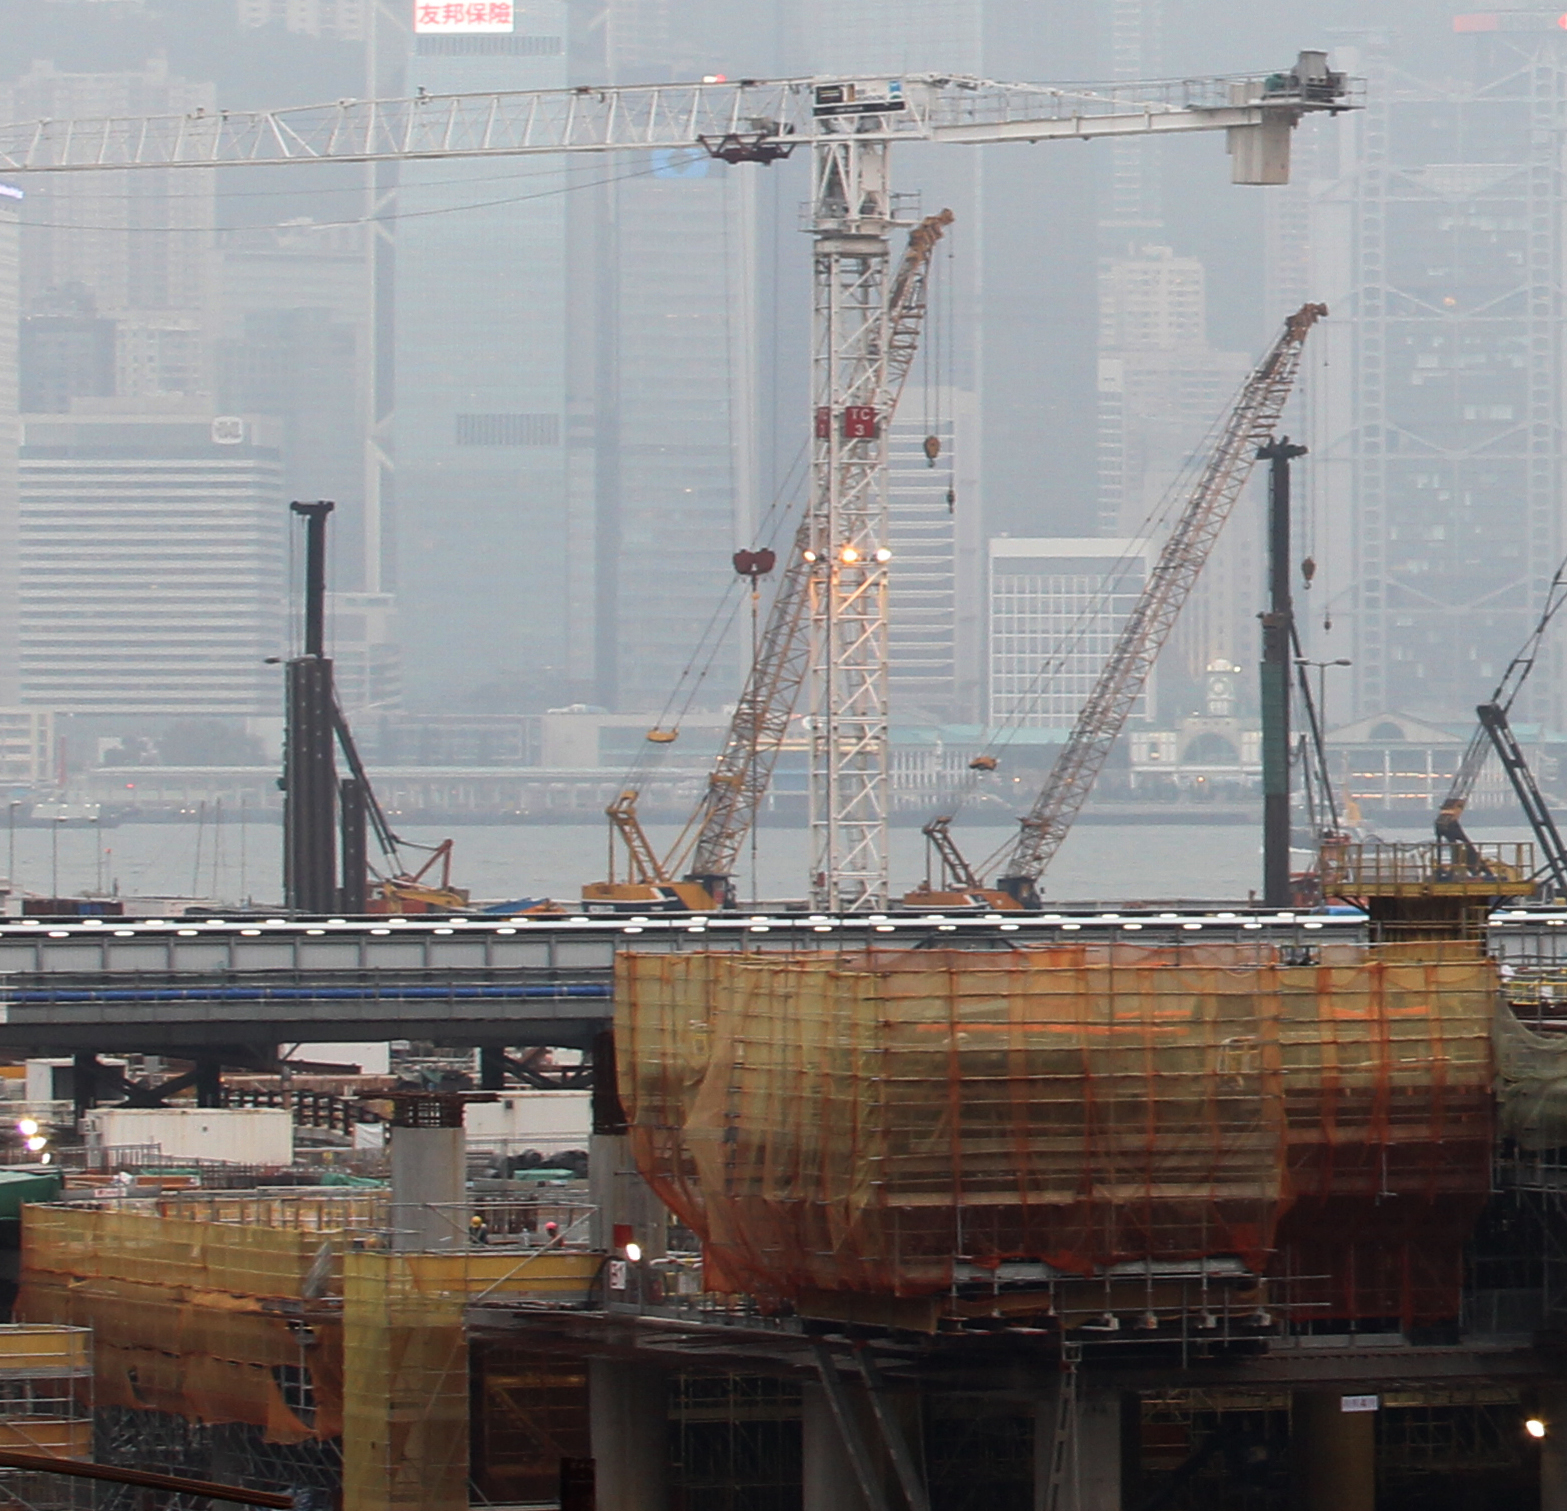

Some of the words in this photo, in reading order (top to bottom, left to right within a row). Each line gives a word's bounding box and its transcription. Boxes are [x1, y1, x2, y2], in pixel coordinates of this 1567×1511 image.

[418, 2, 513, 25] 友邦保險
[852, 408, 871, 421] TC
[854, 423, 865, 436] 3
